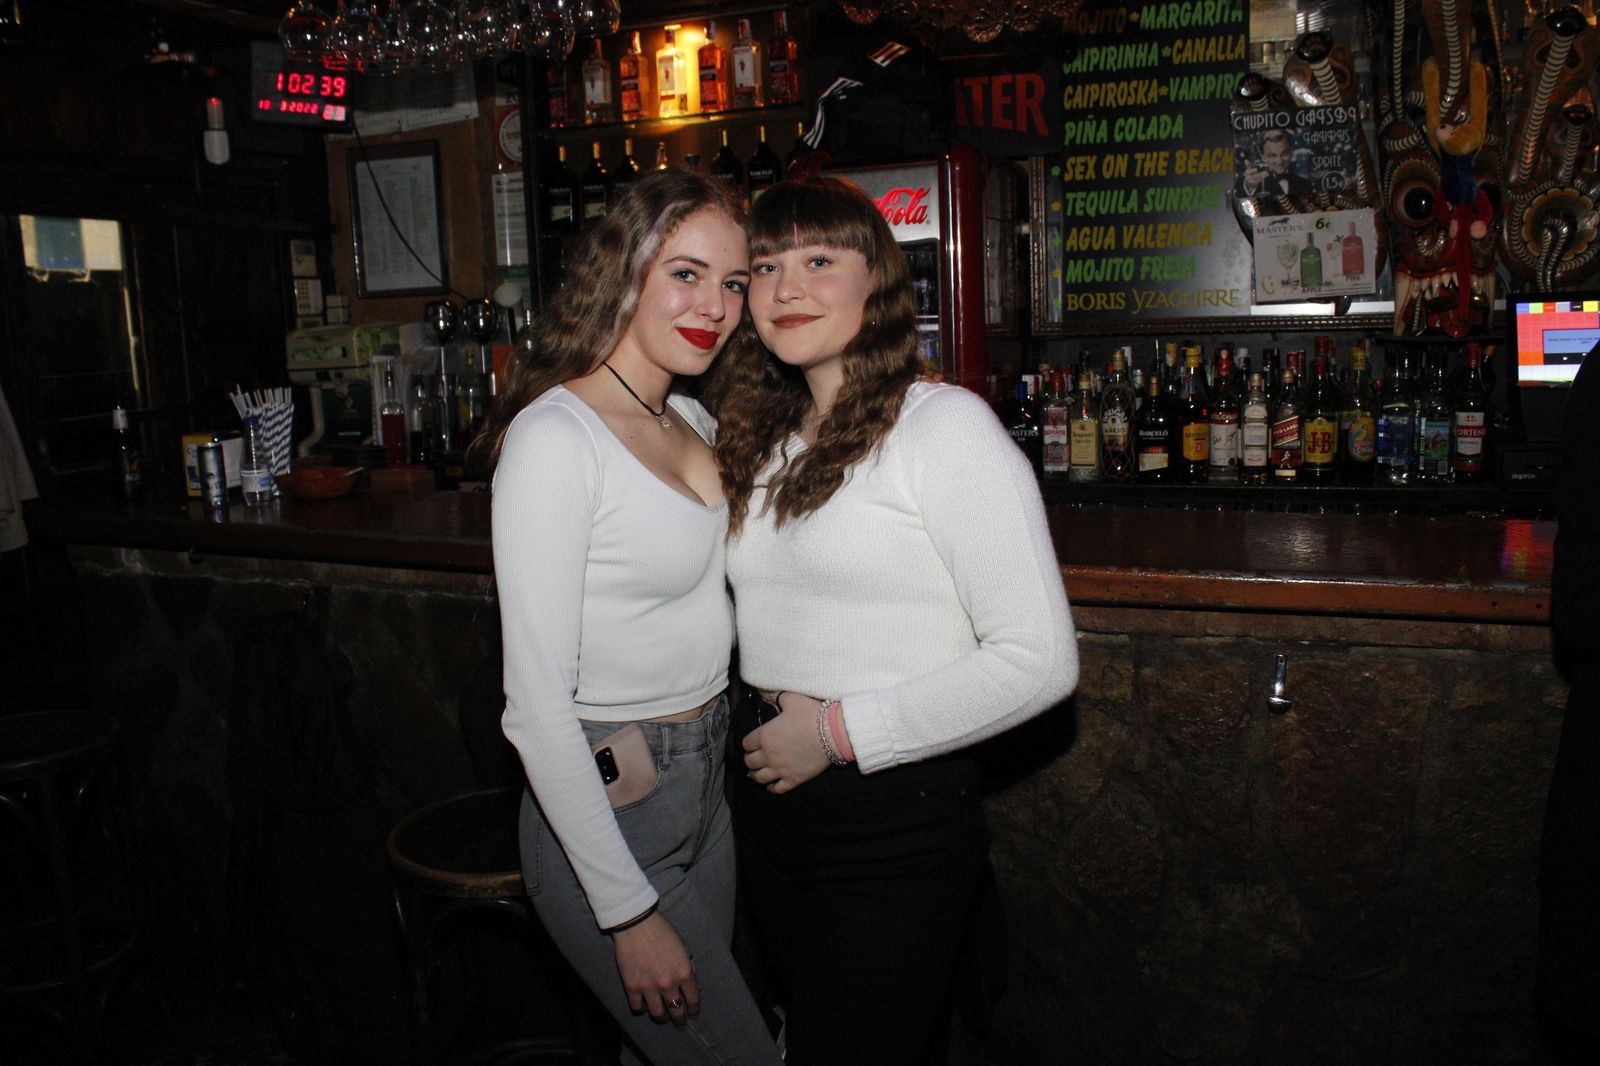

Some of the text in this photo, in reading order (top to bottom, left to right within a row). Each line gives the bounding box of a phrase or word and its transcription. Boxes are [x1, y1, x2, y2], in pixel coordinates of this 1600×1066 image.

[1063, 8, 1126, 35] MOJITO
[1172, 33, 1247, 66] CANALLA
[319, 74, 347, 98] 39
[1063, 78, 1160, 110] CAIPIROSKA
[1064, 113, 1184, 146] PIÑA COLADA
[1234, 112, 1290, 131] CHUPITO
[1063, 148, 1235, 183] SEX ON THE BEACH
[1312, 154, 1342, 170] SPRITE
[1065, 184, 1222, 218] TEQUILA SUNRISE
[1066, 221, 1213, 252] AGUA VALENCIA
[1066, 255, 1135, 284] MOJITO
[1066, 290, 1126, 312] BORIS
